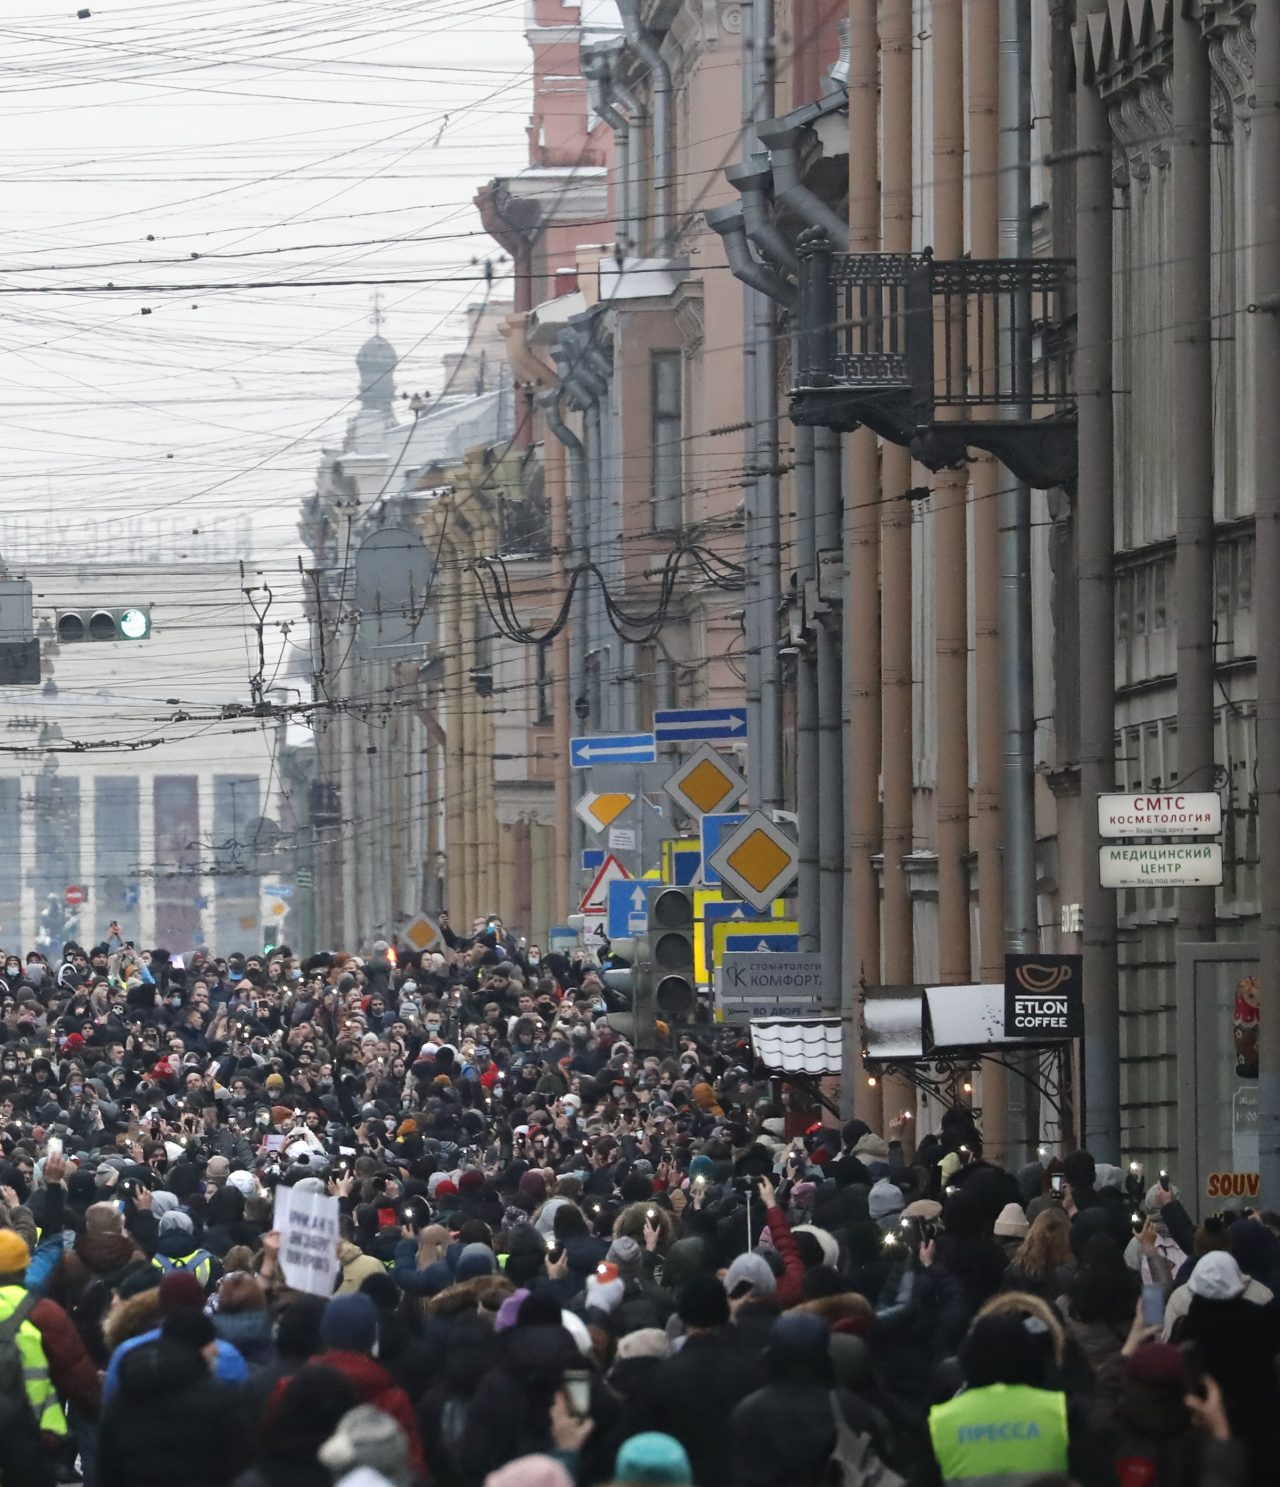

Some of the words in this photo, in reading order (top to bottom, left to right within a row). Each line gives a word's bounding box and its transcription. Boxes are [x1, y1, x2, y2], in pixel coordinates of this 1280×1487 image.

[1134, 797, 1185, 811] СМТС
[1109, 814, 1211, 825] КОСМЕТОЛОГИЯ
[1110, 847, 1212, 861] МЕДИЦИНСКИЙ
[1141, 864, 1182, 875] ЦЕНТР
[753, 1007, 767, 1016] ВО
[770, 1007, 802, 1017] ДВОРЕ
[1015, 1001, 1068, 1014] ETLON
[1015, 1017, 1068, 1028] COFFEE
[1207, 1172, 1260, 1197] SOUV
[957, 1421, 1041, 1445] ПРЕССА
